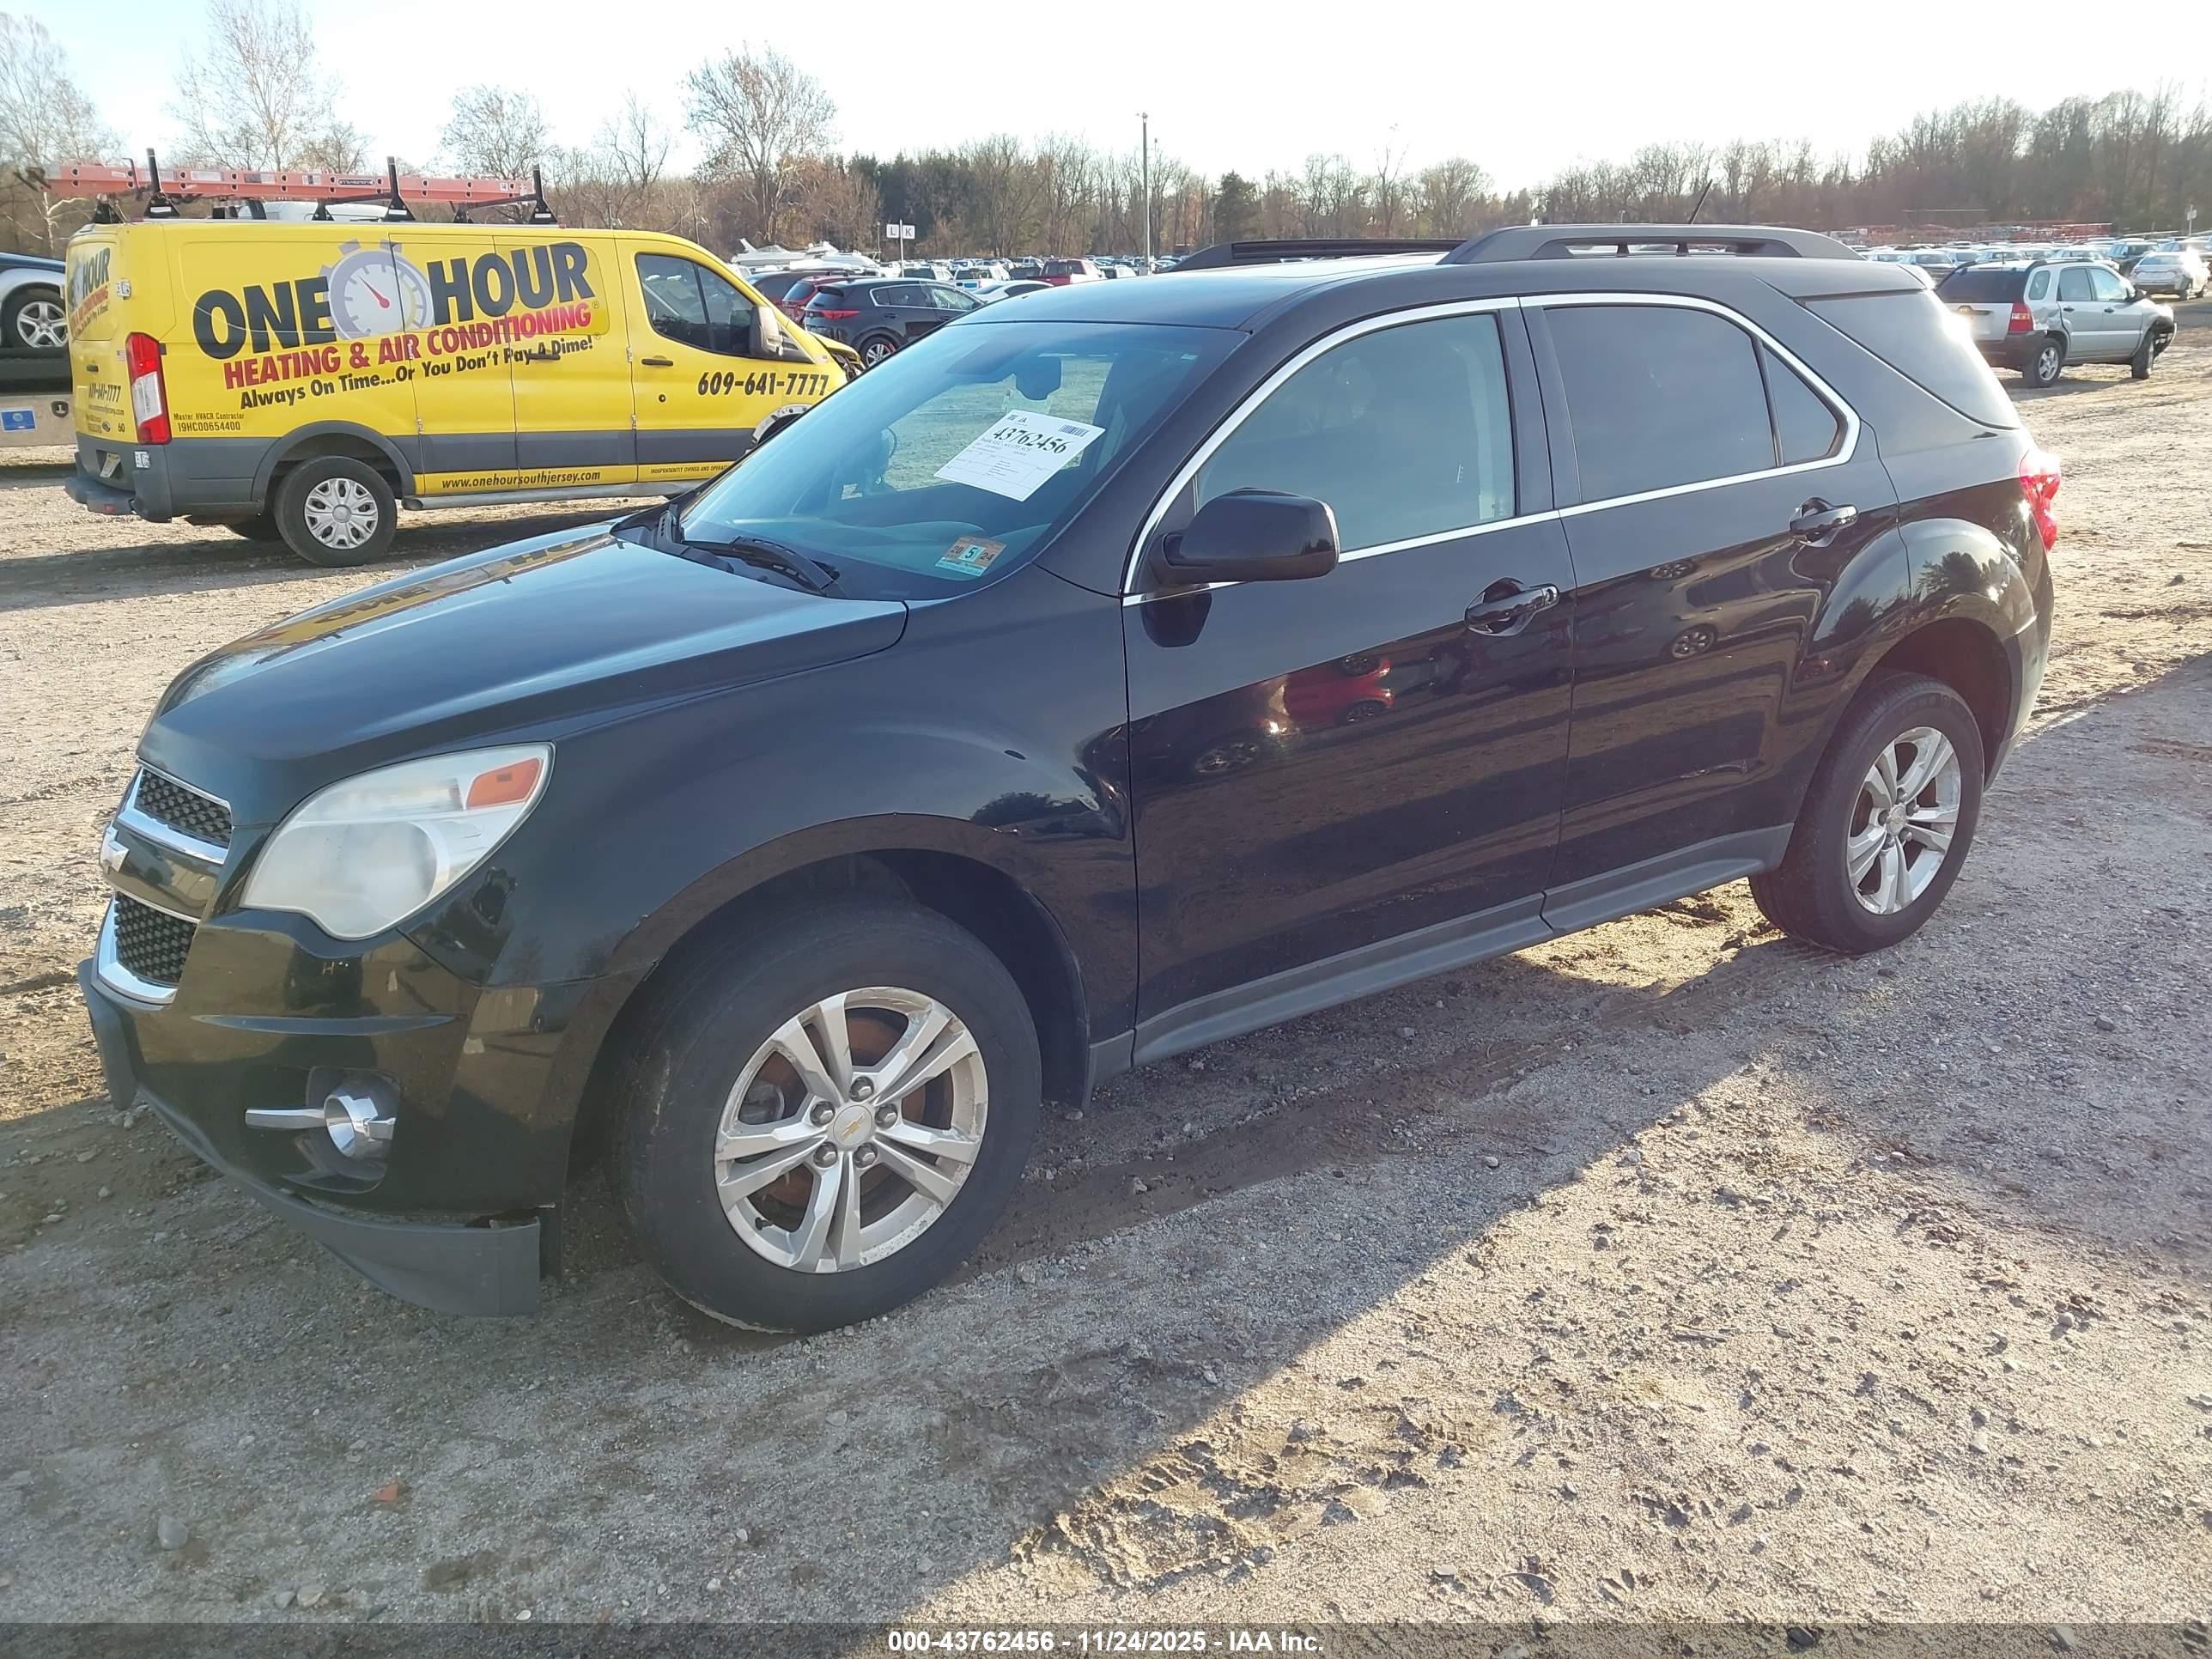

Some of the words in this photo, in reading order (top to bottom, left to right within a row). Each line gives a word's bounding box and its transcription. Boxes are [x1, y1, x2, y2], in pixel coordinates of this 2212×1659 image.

[890, 227, 896, 235] L
[906, 228, 912, 236] K
[193, 276, 337, 359] ONE
[427, 241, 596, 325] HOUR
[223, 346, 341, 389] HEATING
[349, 342, 370, 368] &
[378, 333, 421, 365] AIR
[427, 302, 592, 356] CONDITIONING
[240, 389, 306, 410] Always
[310, 379, 335, 396] On
[422, 357, 451, 378] You
[456, 350, 498, 372] Don't
[504, 347, 532, 365] Pay
[551, 335, 593, 356] Dime!
[697, 371, 830, 396] 609-641-7777
[994, 427, 1075, 453] 43762456
[442, 471, 601, 489] www.onehoursouthjersey.com
[965, 547, 978, 559] 5
[980, 552, 995, 562] 24
